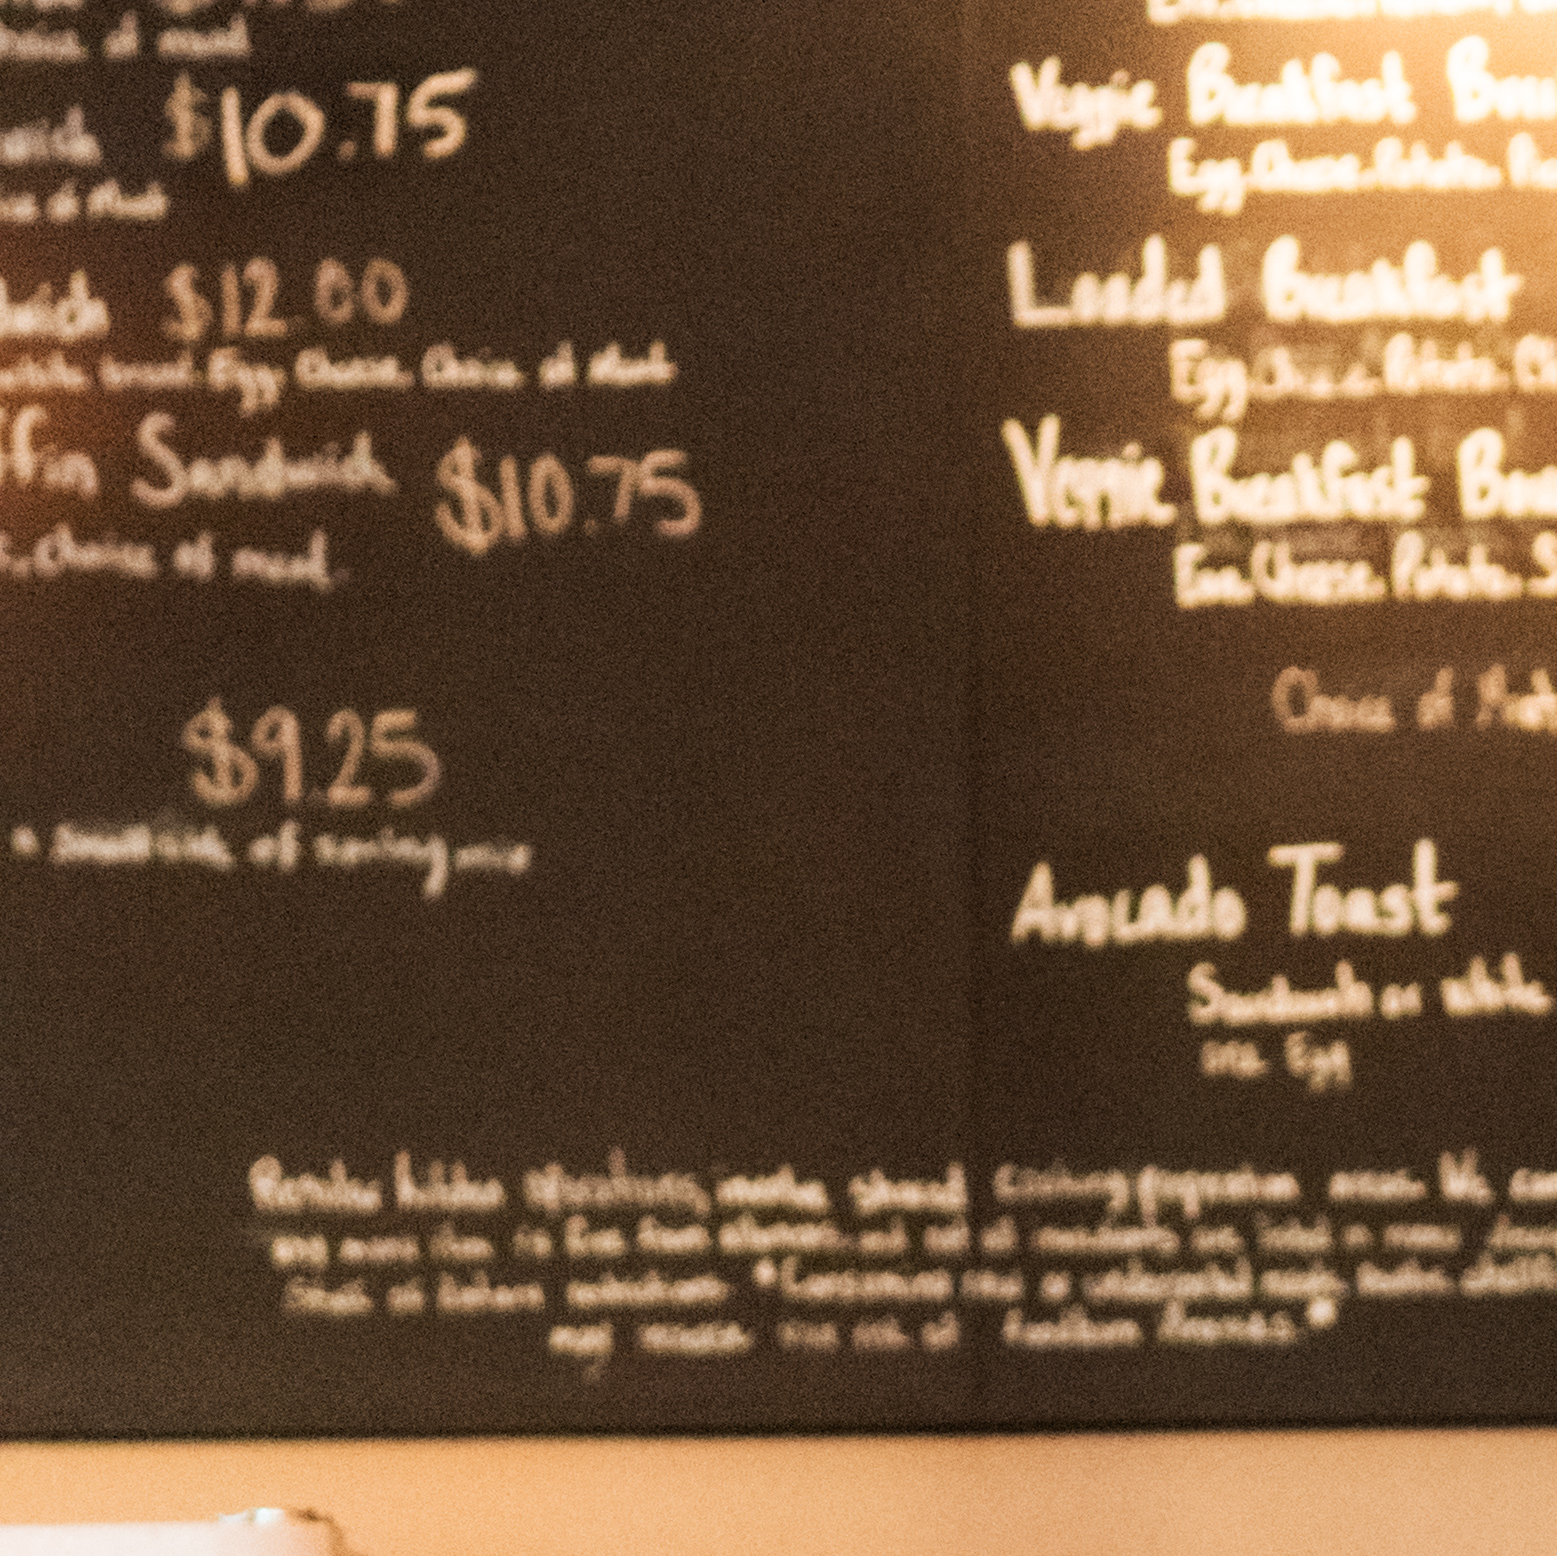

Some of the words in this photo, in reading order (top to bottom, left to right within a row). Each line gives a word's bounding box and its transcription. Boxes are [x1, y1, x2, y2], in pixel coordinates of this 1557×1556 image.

[162, 68, 478, 187] $10.75
[1009, 55, 1163, 150] Veggie
[1186, 41, 1418, 128] Breakfast
[163, 256, 410, 340] $12.00
[1007, 234, 1227, 329] Loaded
[1260, 235, 1523, 325] Breakfast
[131, 410, 397, 510] Sandwich
[433, 436, 703, 556] $10.75
[1001, 412, 1177, 532] Veggie
[1189, 424, 1432, 525] Breakfast
[182, 694, 443, 808] $9.25
[1010, 854, 1248, 947] Avocado
[1266, 838, 1462, 938] Toast
